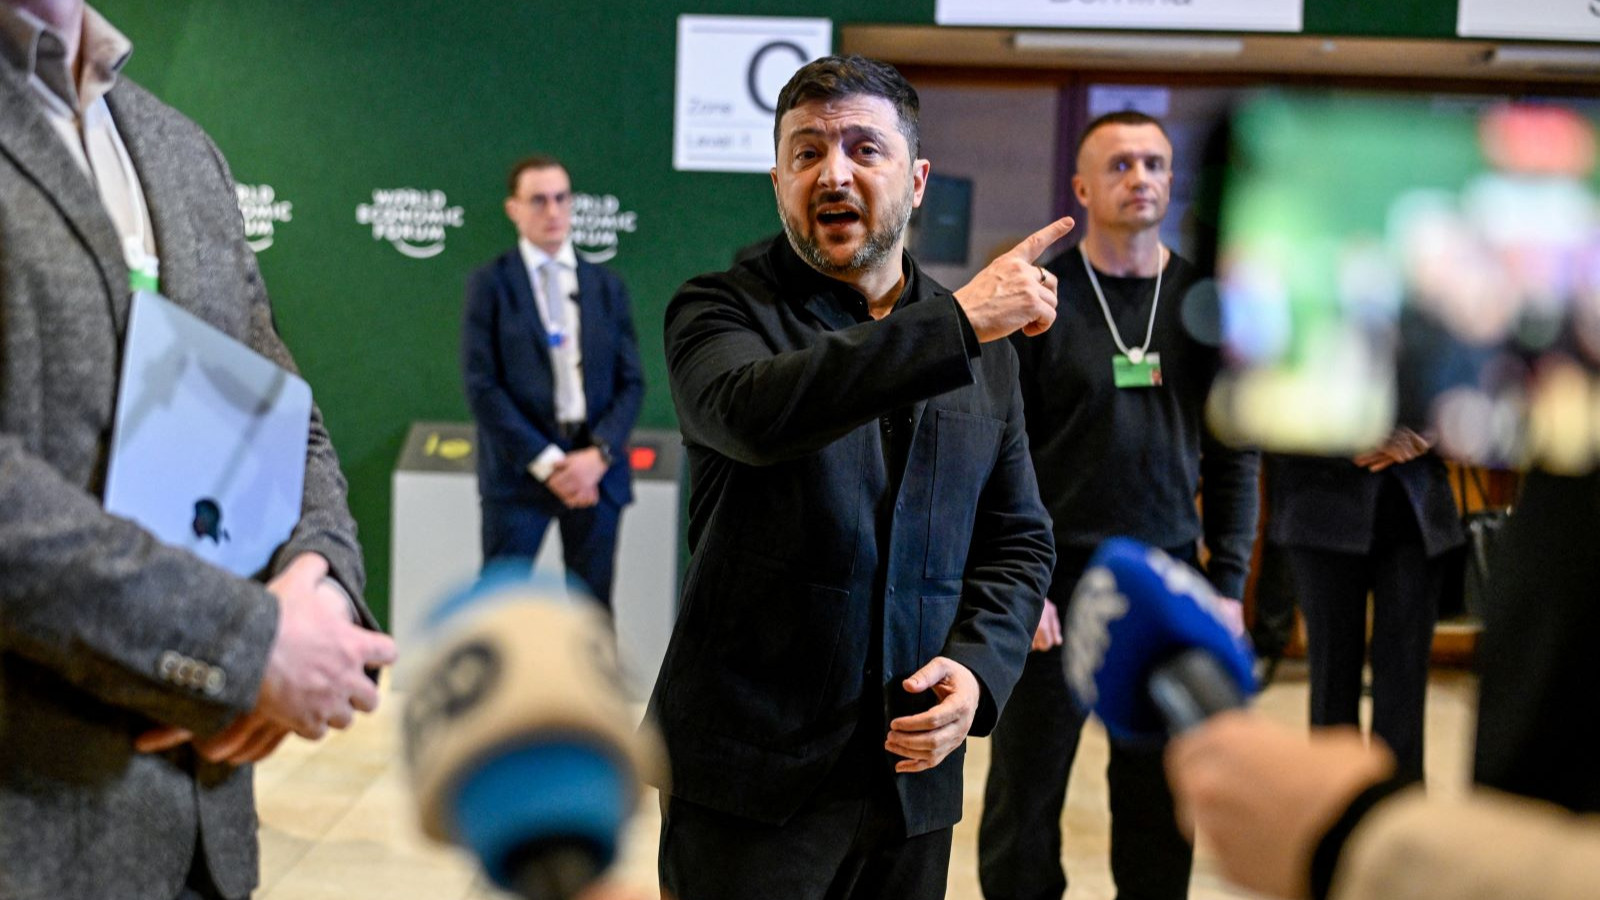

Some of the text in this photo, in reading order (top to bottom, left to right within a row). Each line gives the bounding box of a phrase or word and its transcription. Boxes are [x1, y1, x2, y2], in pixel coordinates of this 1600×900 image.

[747, 41, 808, 114] C
[372, 189, 446, 209] WORLD
[356, 203, 464, 227] ECONOMIC
[372, 223, 446, 242] FORUM
